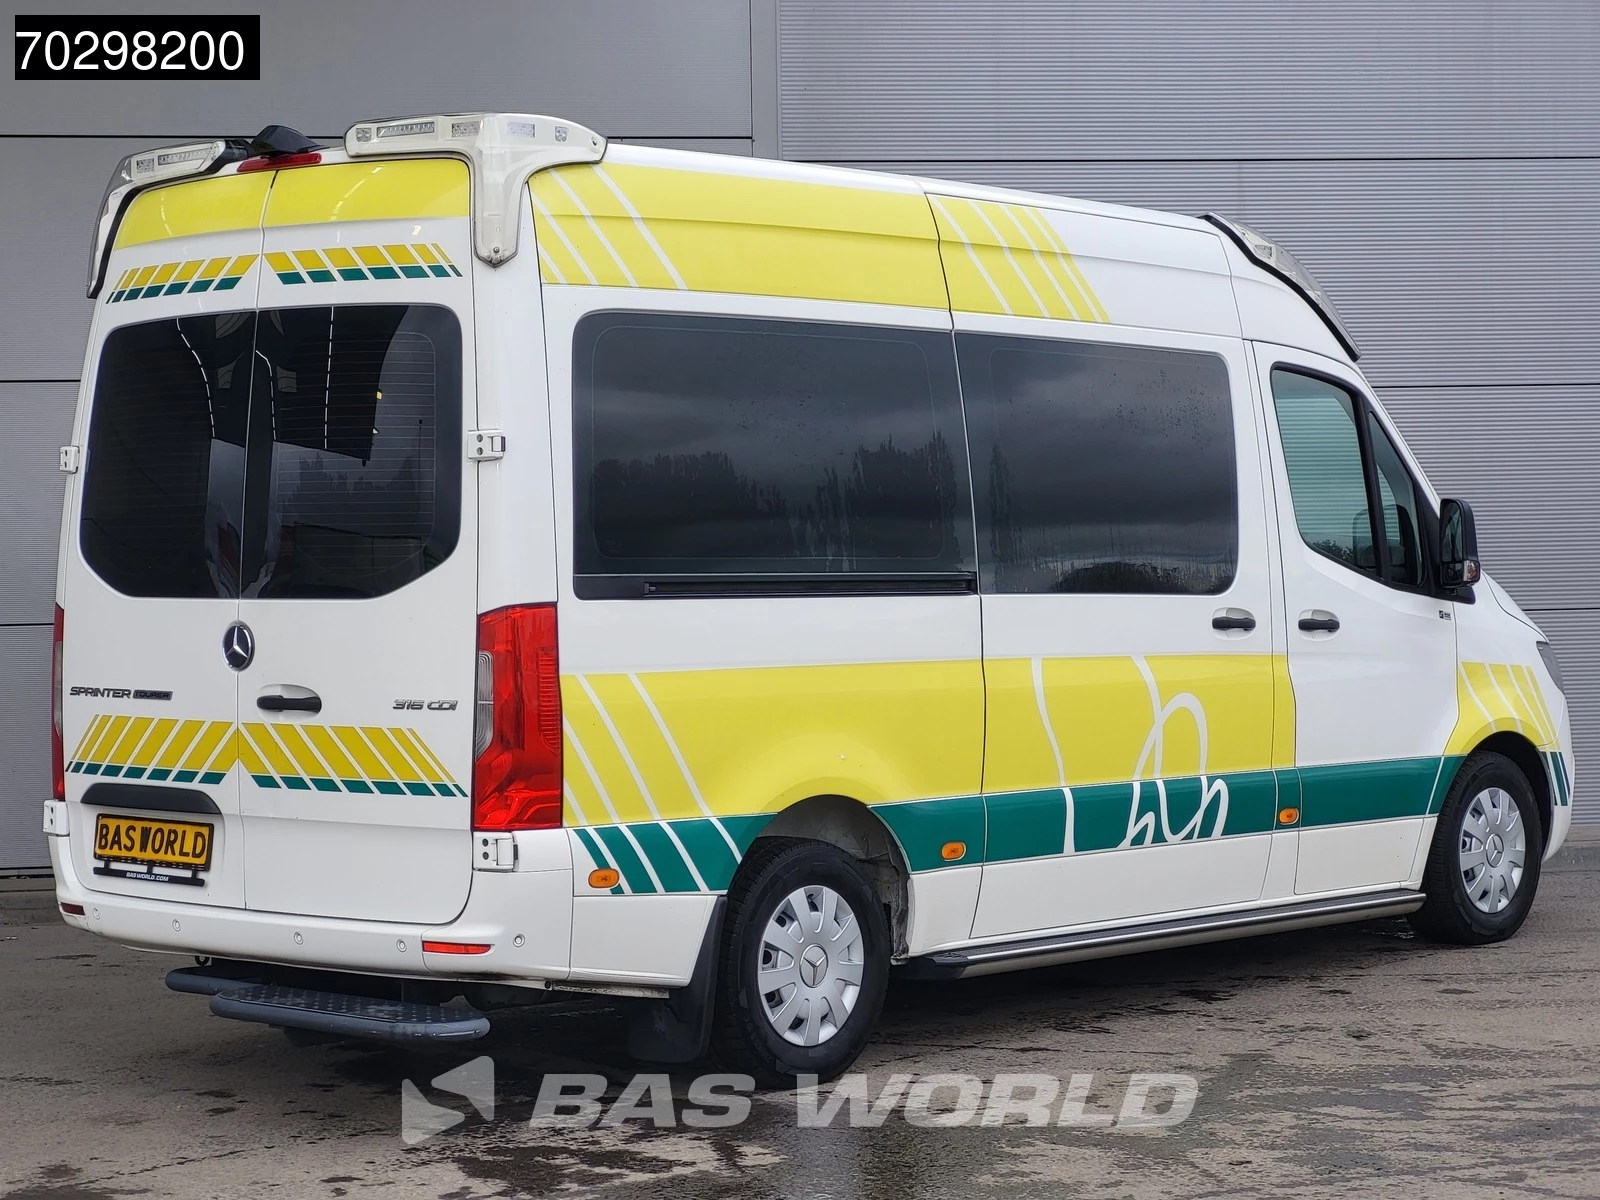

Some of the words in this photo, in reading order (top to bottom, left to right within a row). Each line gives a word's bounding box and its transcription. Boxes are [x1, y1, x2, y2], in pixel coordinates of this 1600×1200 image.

[69, 686, 131, 699] SPRINTER
[135, 690, 171, 700] TOURER
[392, 699, 425, 710] 316
[427, 699, 458, 711] CDI
[98, 823, 136, 852] BAS
[139, 826, 207, 858] WORLD
